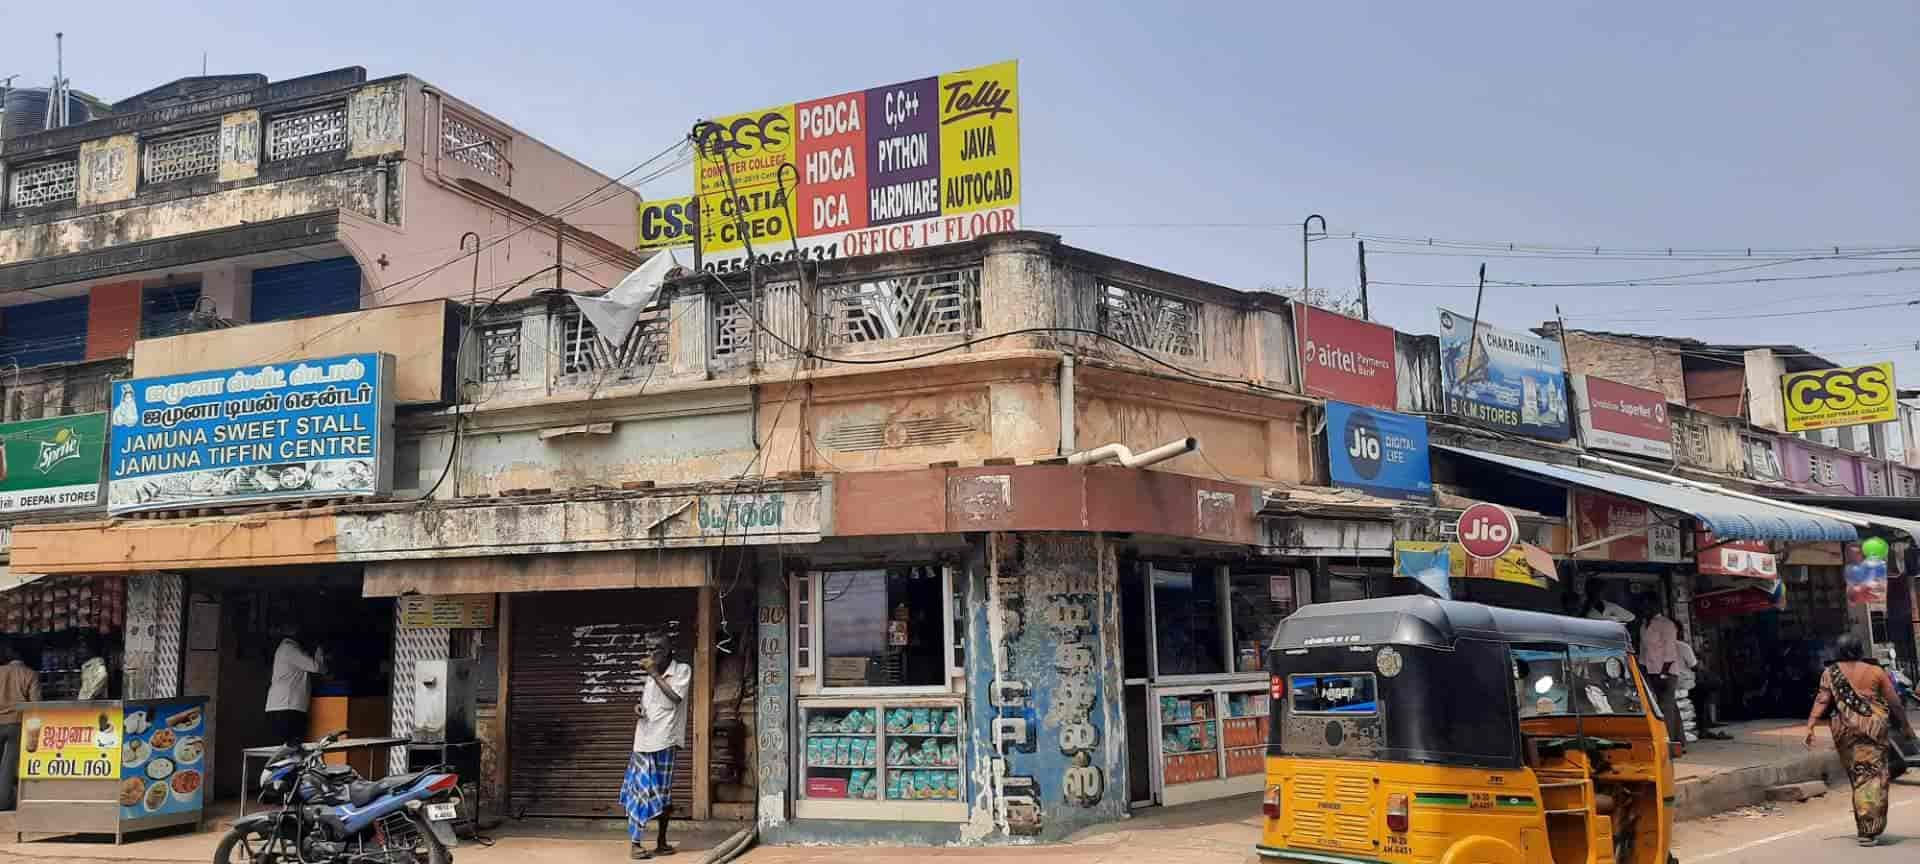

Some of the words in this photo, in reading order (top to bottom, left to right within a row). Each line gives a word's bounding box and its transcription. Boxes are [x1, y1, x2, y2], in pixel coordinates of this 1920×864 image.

[885, 90, 919, 131] C,C++
[942, 80, 1013, 124] Tally
[800, 99, 860, 140] PGDCA
[698, 112, 791, 163] CSS
[879, 133, 928, 173] PYTHON
[960, 126, 996, 160] JAVA
[703, 161, 746, 179] COMTER
[805, 147, 856, 185] HDCA
[720, 188, 788, 217] CATIA
[870, 178, 938, 220] HARDWARE
[946, 168, 1012, 208] AUTOCAD
[813, 194, 849, 231] DCA
[721, 216, 782, 244] CREO
[842, 225, 915, 257] OFFICE
[944, 208, 1016, 243] FLOOR
[1318, 344, 1356, 374] airtel
[1486, 333, 1550, 361] CHAKRAVARTHI
[1358, 365, 1376, 377] Bank
[143, 402, 219, 427] ஜமுனா
[224, 392, 280, 418] டிபன்
[285, 384, 372, 411] சென்டர்
[1787, 366, 1889, 414] CSS
[1480, 405, 1518, 426] STORES
[121, 431, 208, 454] JAMUNA
[213, 419, 290, 443] SWEET
[296, 414, 366, 434] STALL
[1350, 427, 1380, 460] Jio
[1385, 434, 1416, 450] DIGITAL
[40, 438, 78, 468] Sprite
[115, 450, 201, 477] JAMUNA
[208, 445, 273, 465] TIFFIN
[280, 436, 371, 459] CENTRE
[1386, 448, 1406, 464] LIFE
[20, 495, 56, 506] DEEPAK
[56, 491, 96, 503] STORES
[1464, 517, 1508, 542] Jio
[43, 725, 94, 749] ஜமுனா
[27, 758, 41, 776] டீ
[47, 752, 112, 777] ஸ்டால்
